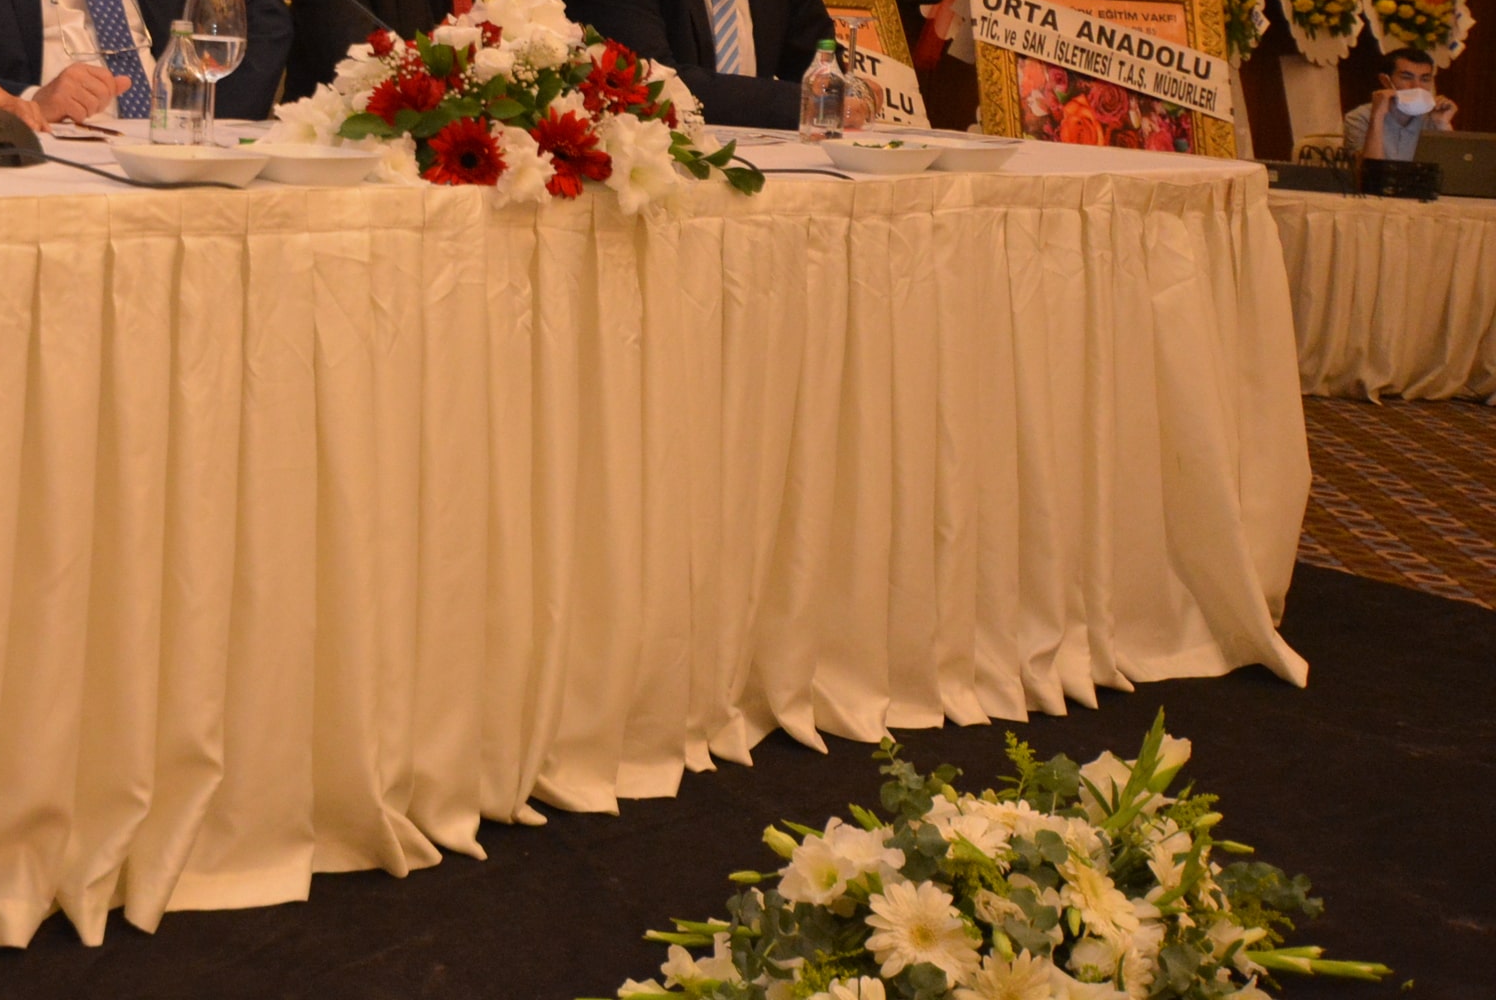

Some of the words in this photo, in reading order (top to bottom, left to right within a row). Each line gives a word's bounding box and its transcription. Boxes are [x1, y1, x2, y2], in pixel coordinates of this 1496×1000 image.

[980, 12, 1000, 41] TİC.
[1004, 27, 1017, 46] ve
[1154, 70, 1219, 113] MÜDÜRLERİ
[1076, 20, 1212, 81] ANADOLU
